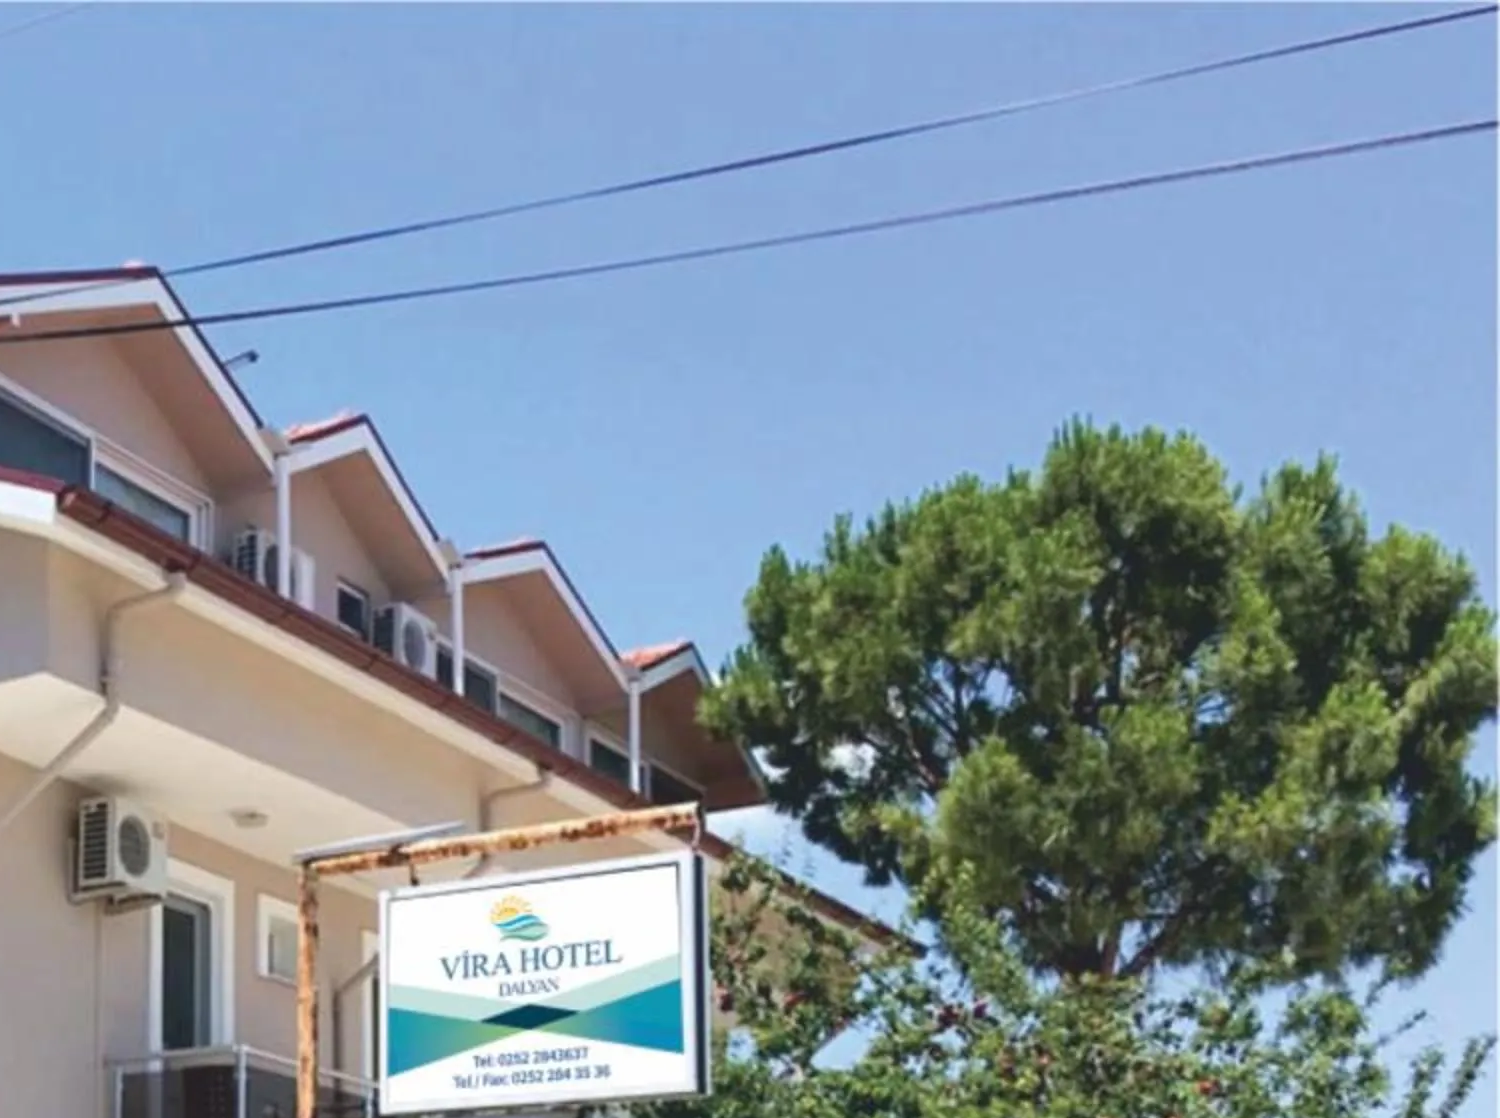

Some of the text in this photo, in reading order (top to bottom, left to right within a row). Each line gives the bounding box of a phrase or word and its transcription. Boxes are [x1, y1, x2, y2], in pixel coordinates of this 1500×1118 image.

[440, 939, 624, 980] VİRA HOTEL
[499, 977, 560, 998] DALYAN
[498, 1052, 530, 1067] 0252
[511, 1069, 544, 1085] 0252
